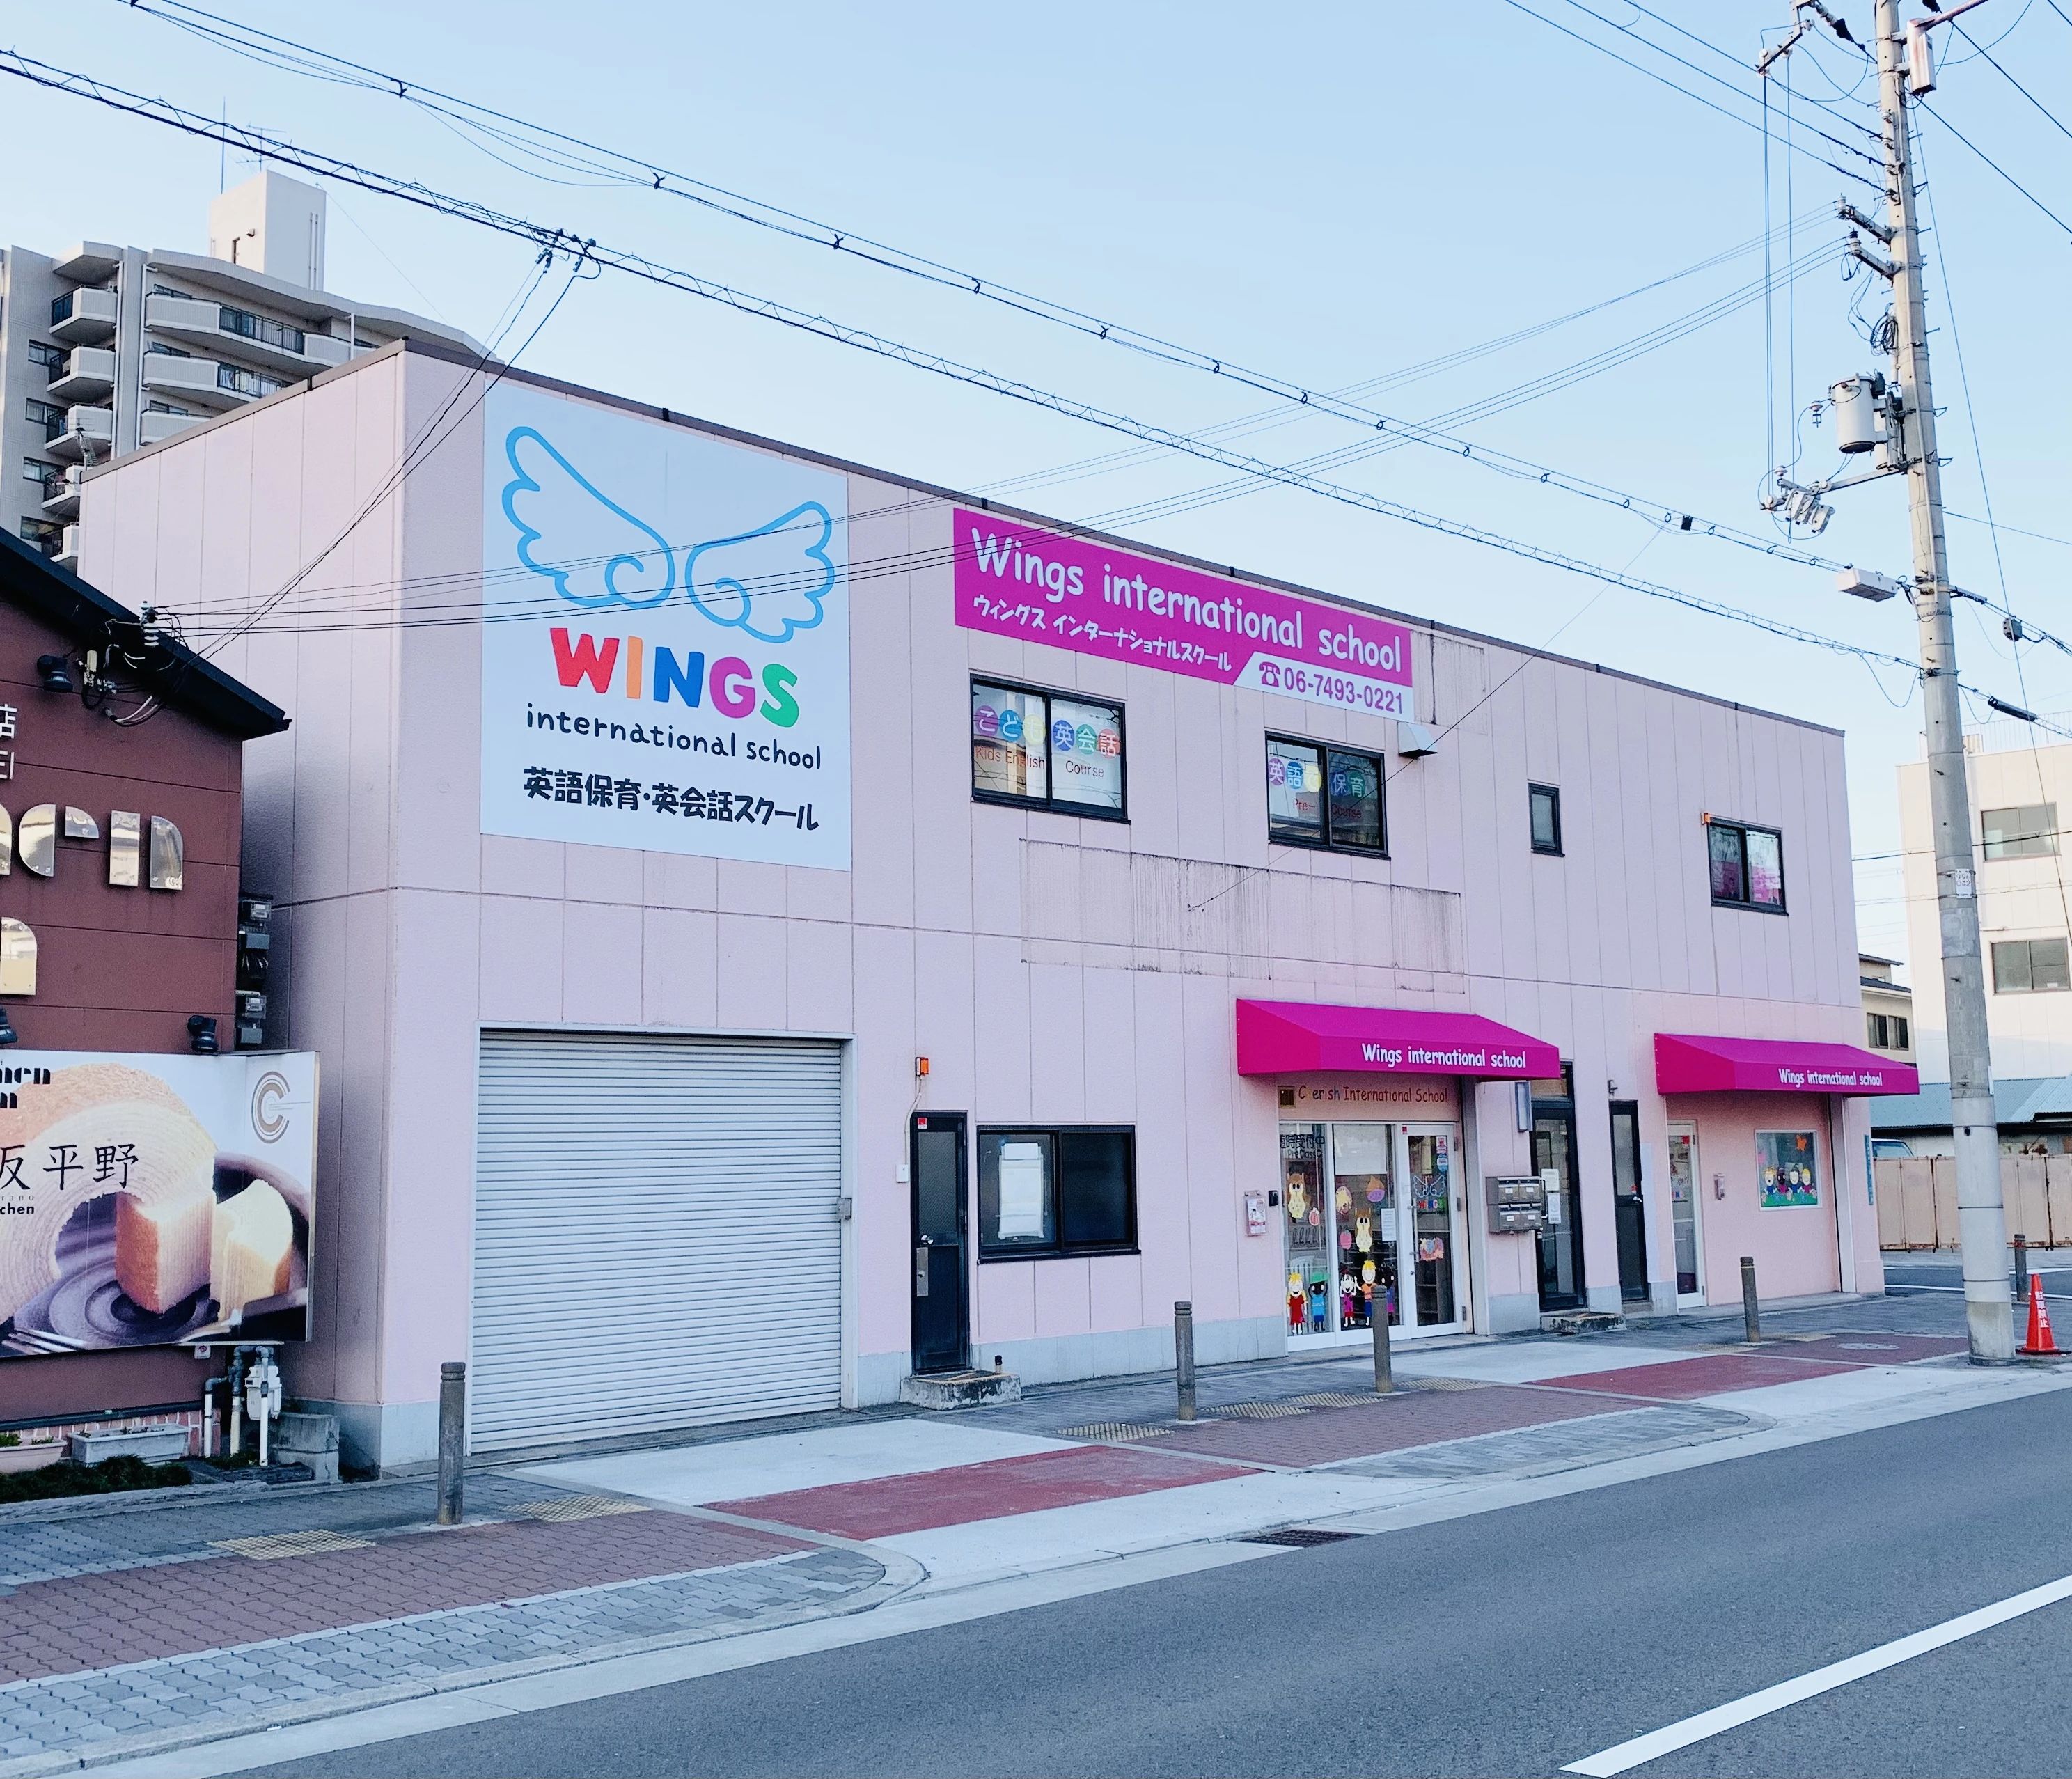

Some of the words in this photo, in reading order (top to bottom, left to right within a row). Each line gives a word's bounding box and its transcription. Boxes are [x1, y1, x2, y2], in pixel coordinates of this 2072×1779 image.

[971, 527, 1084, 603] Wings
[1104, 563, 1303, 650] international
[1317, 623, 1402, 673] school
[973, 594, 1046, 630] ウィングス
[1053, 613, 1232, 672] インターナショナルスクール
[549, 627, 800, 728] WINGS
[1284, 669, 1403, 715] 06-7493-0221
[526, 703, 735, 757] international
[746, 739, 822, 769] school
[1055, 723, 1117, 756] 英会話
[975, 746, 1001, 762] Kids
[1005, 746, 1045, 769] English
[1065, 760, 1104, 778] Course
[523, 765, 819, 831] 英語保育・英会話スクール
[1362, 1043, 1402, 1067] Wings
[1408, 1046, 1486, 1067] international
[1491, 1050, 1526, 1068] school
[1778, 1068, 1805, 1088] Wings
[1807, 1070, 1856, 1086] international
[1860, 1071, 1883, 1086] school
[1298, 1085, 1340, 1101] Cerish
[1343, 1086, 1411, 1103] International
[1415, 1088, 1447, 1103] School
